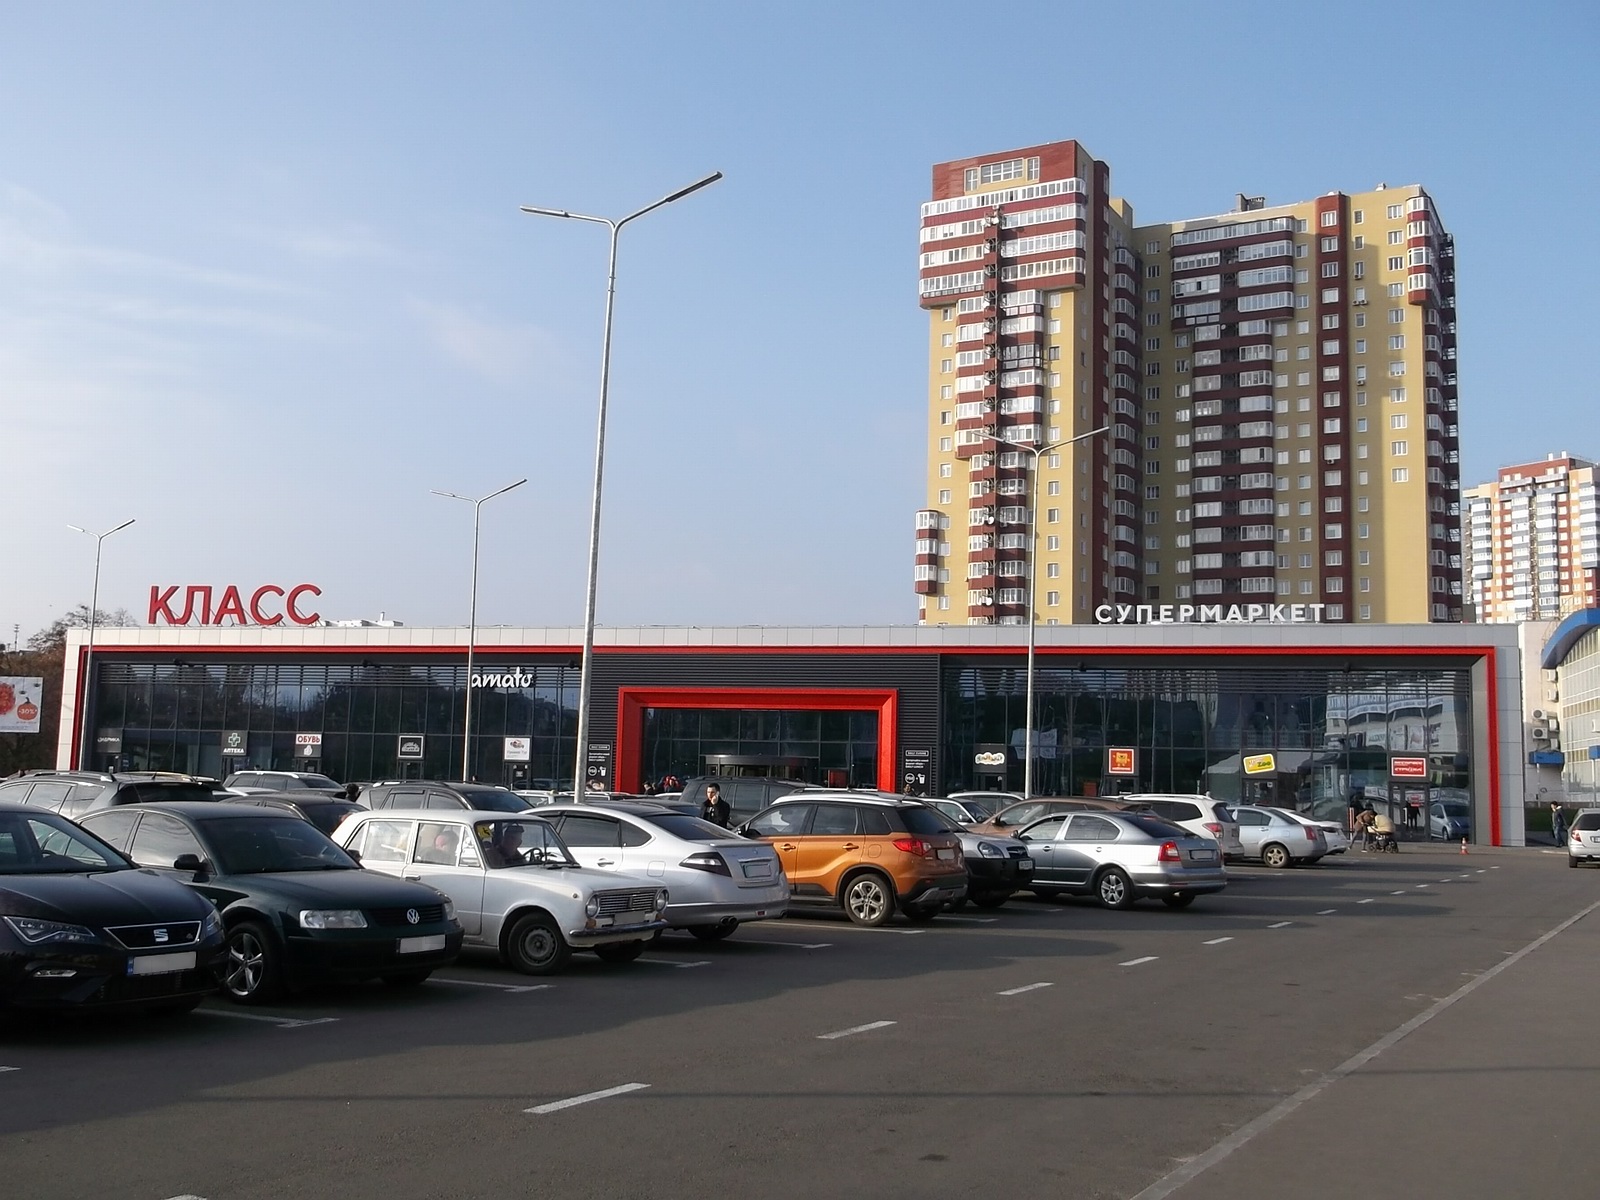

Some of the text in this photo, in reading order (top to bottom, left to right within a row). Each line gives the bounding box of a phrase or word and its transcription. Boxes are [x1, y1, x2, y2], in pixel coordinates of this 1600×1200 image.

[148, 583, 322, 625] КЛАСС
[1095, 603, 1325, 623] СУПЕРМАРКЕТ
[297, 735, 320, 743] ОБУВЬ
